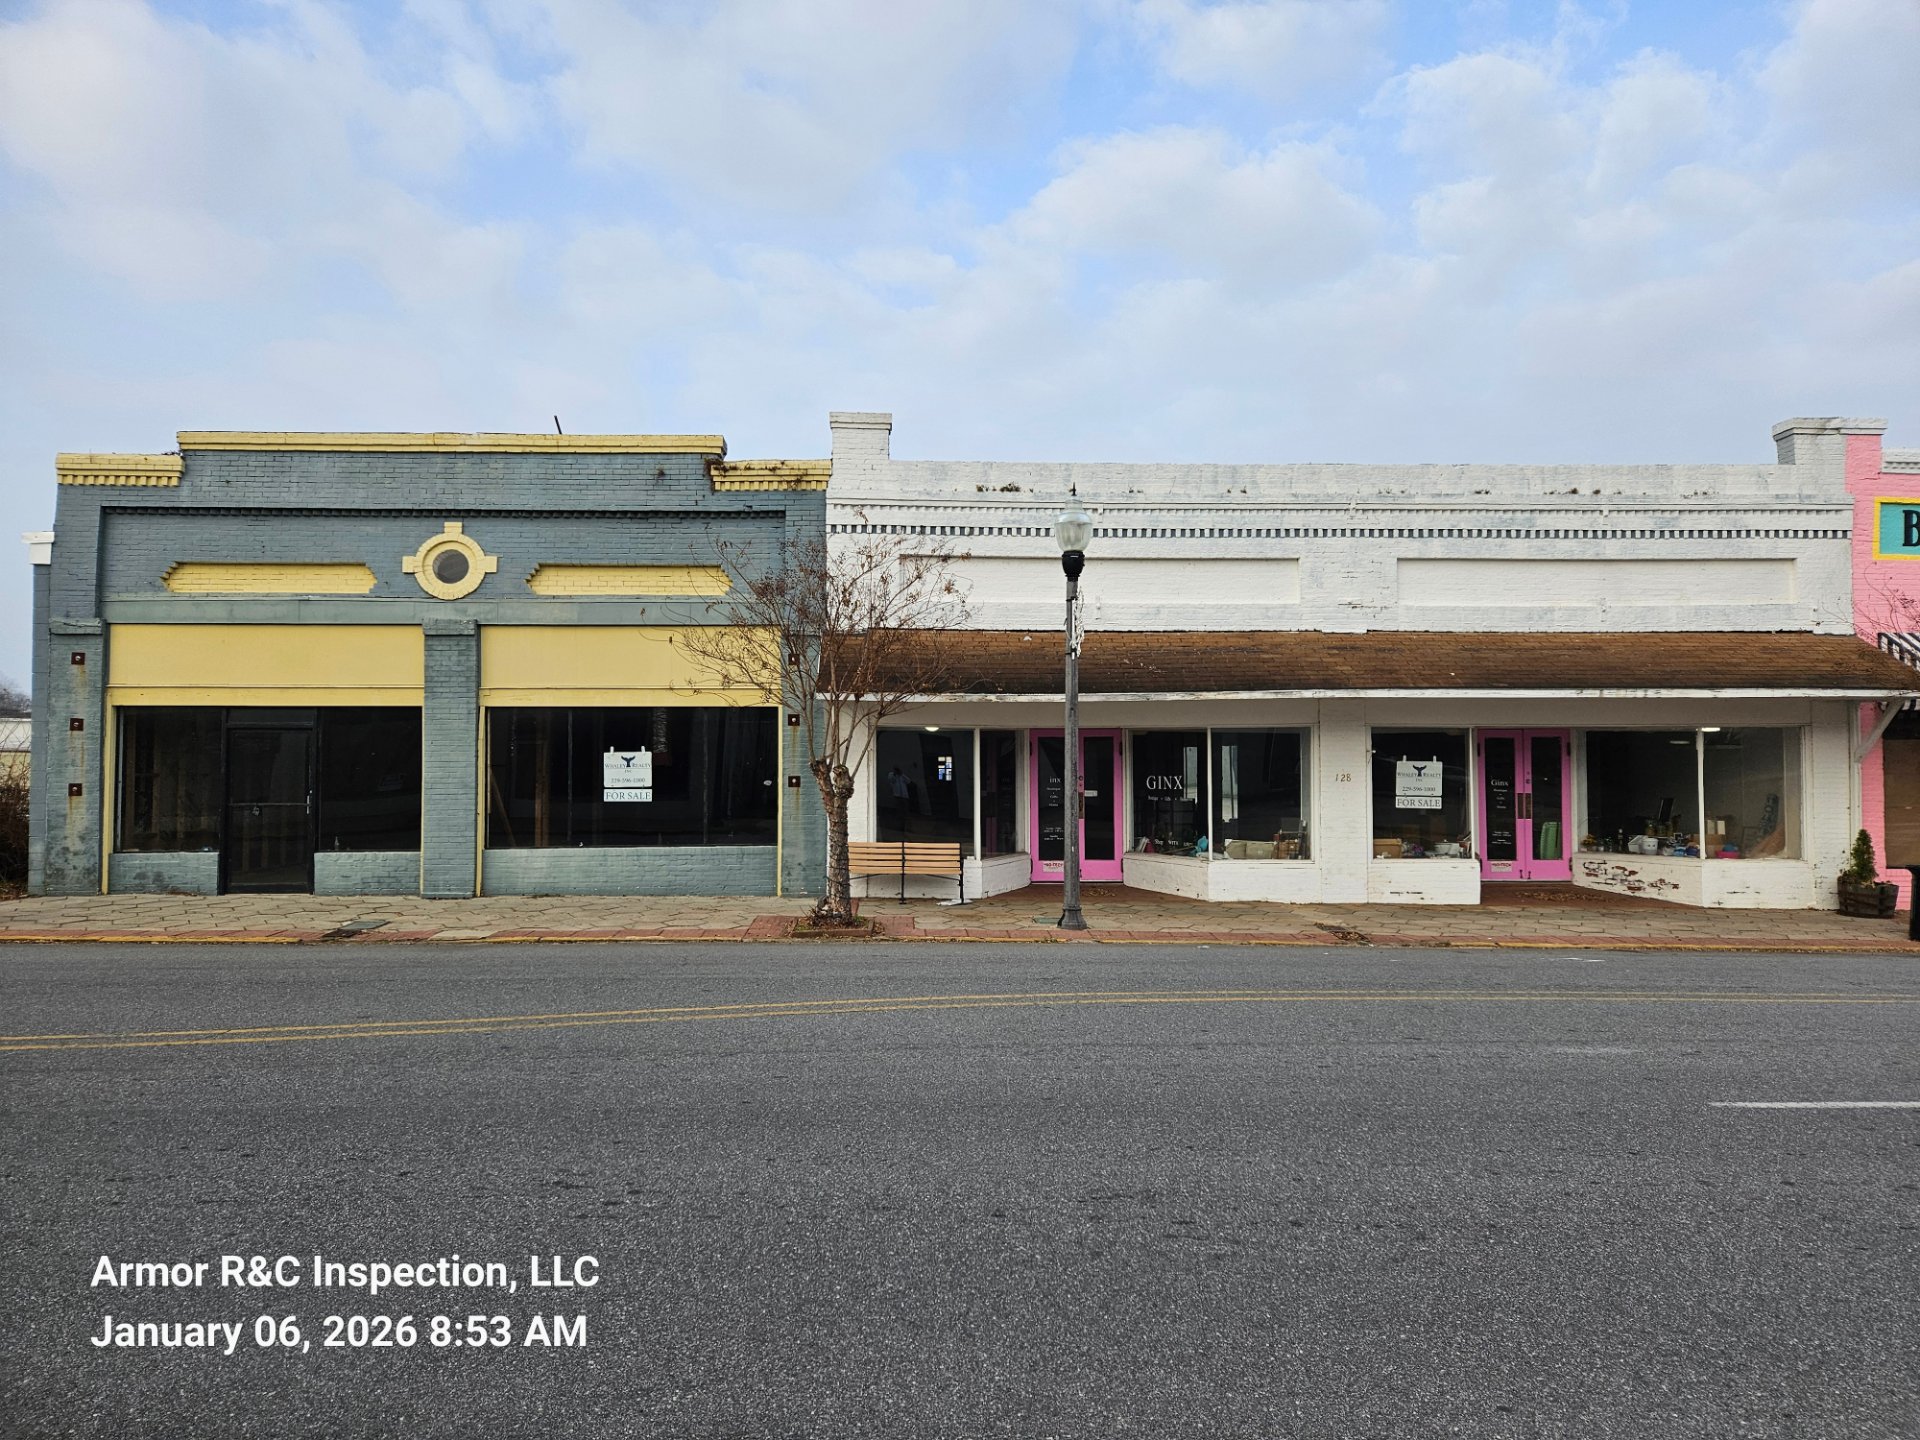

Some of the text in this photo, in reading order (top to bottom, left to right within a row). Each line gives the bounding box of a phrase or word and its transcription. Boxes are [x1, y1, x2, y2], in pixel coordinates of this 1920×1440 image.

[1146, 775, 1183, 790] GINX
[1335, 773, 1351, 783] 128
[1490, 779, 1509, 787] Ginx
[606, 791, 651, 800] FOR SALE
[1397, 799, 1441, 808] FOR SALE
